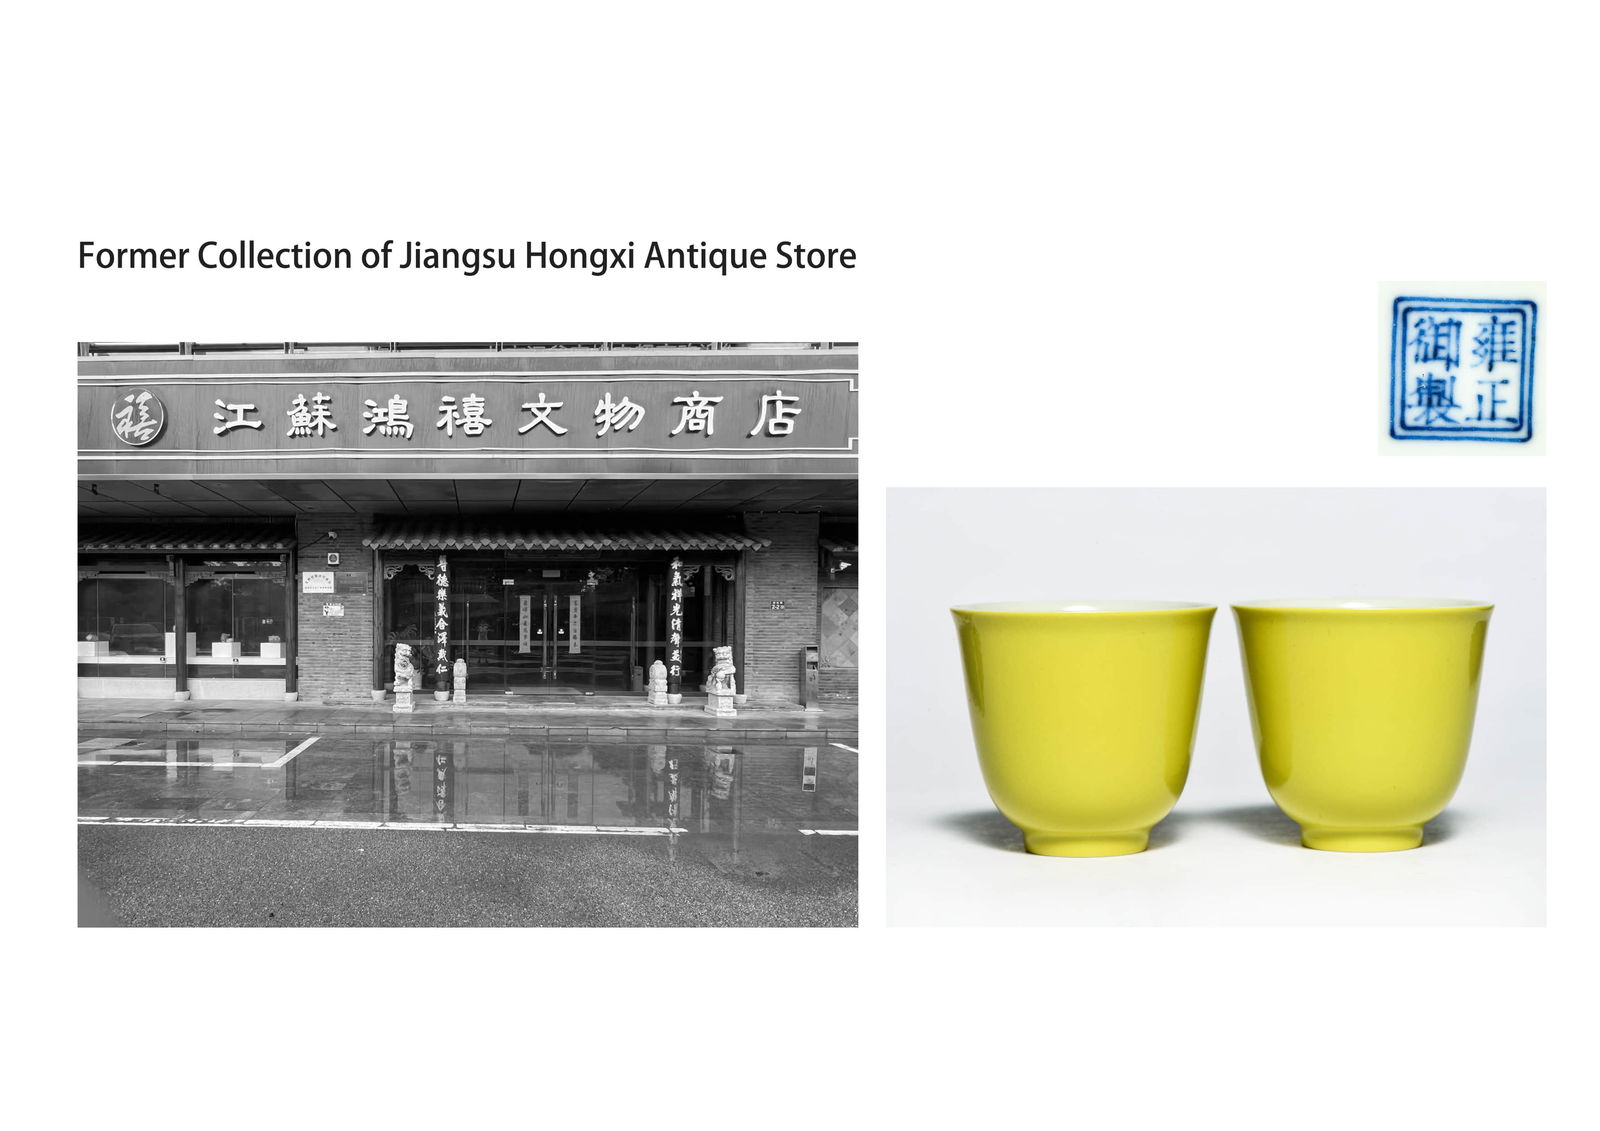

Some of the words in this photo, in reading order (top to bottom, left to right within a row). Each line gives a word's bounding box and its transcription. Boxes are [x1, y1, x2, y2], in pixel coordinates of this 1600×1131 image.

[212, 390, 802, 440] 江蘇鴻禧文物商店
